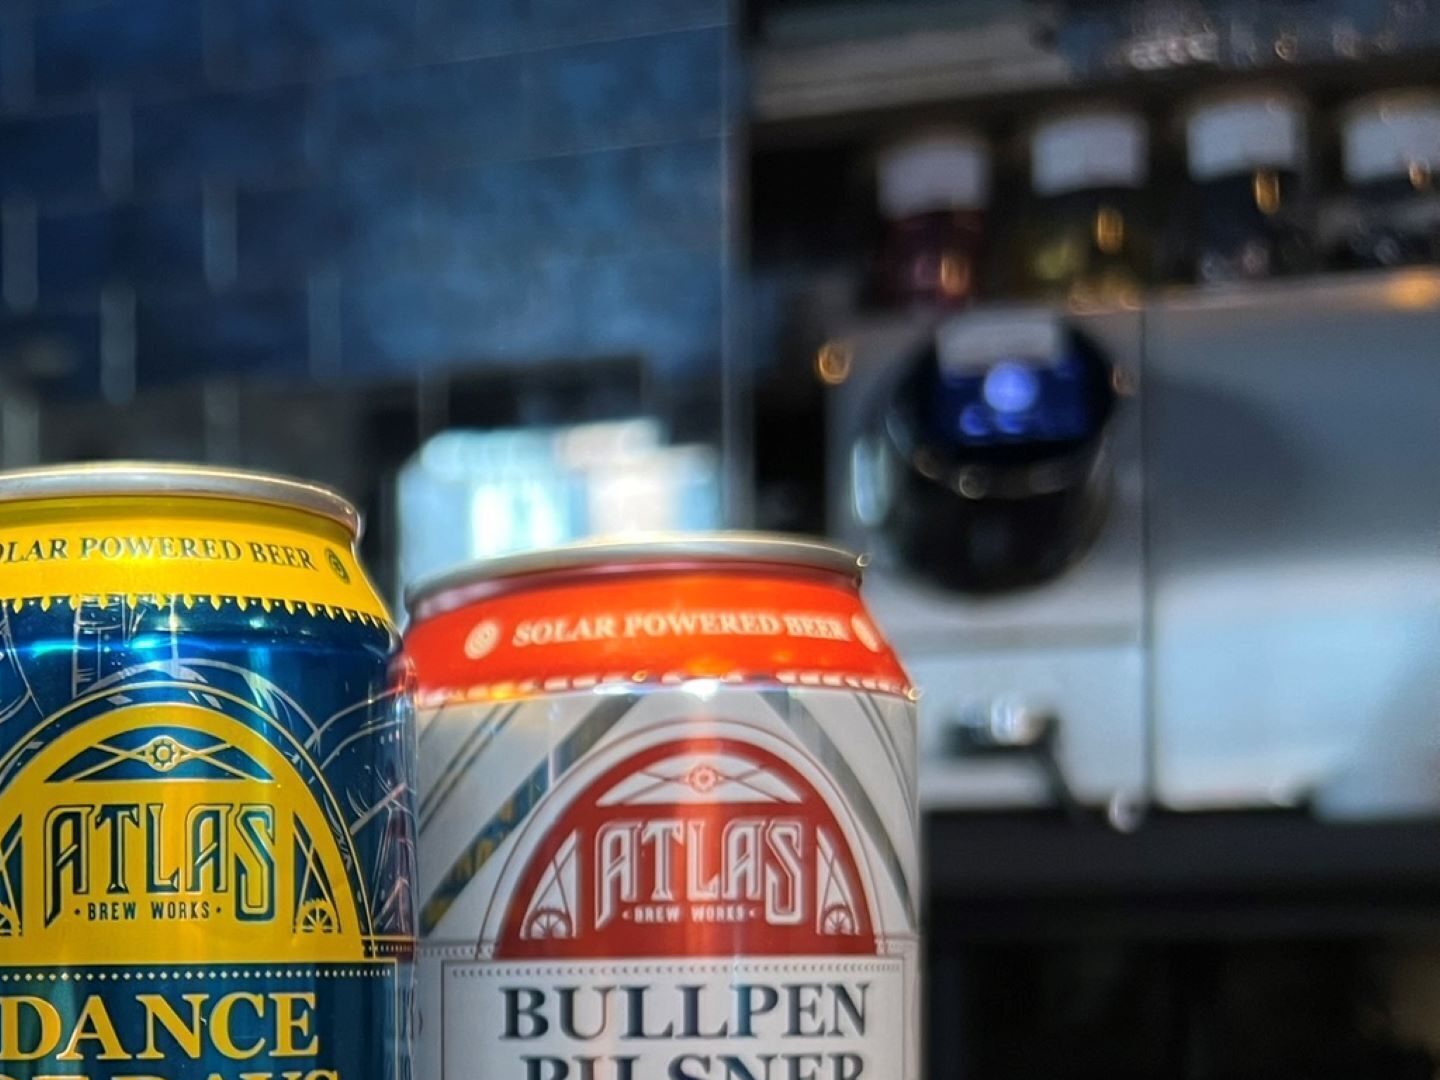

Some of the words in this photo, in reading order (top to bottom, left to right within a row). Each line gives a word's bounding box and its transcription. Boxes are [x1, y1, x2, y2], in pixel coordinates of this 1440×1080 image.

[79, 536, 243, 562] POWERED
[249, 543, 319, 572] BEER
[512, 614, 615, 647] SOLAR
[623, 612, 781, 638] POWERED
[784, 615, 852, 642] BEER
[44, 802, 277, 929] ATLAS
[594, 818, 805, 930] ATLAS
[87, 901, 137, 922] BREW
[151, 900, 211, 921] WORKS
[634, 905, 681, 923] BREW
[691, 905, 745, 923] WORKS
[498, 981, 871, 1041] BULLPEN
